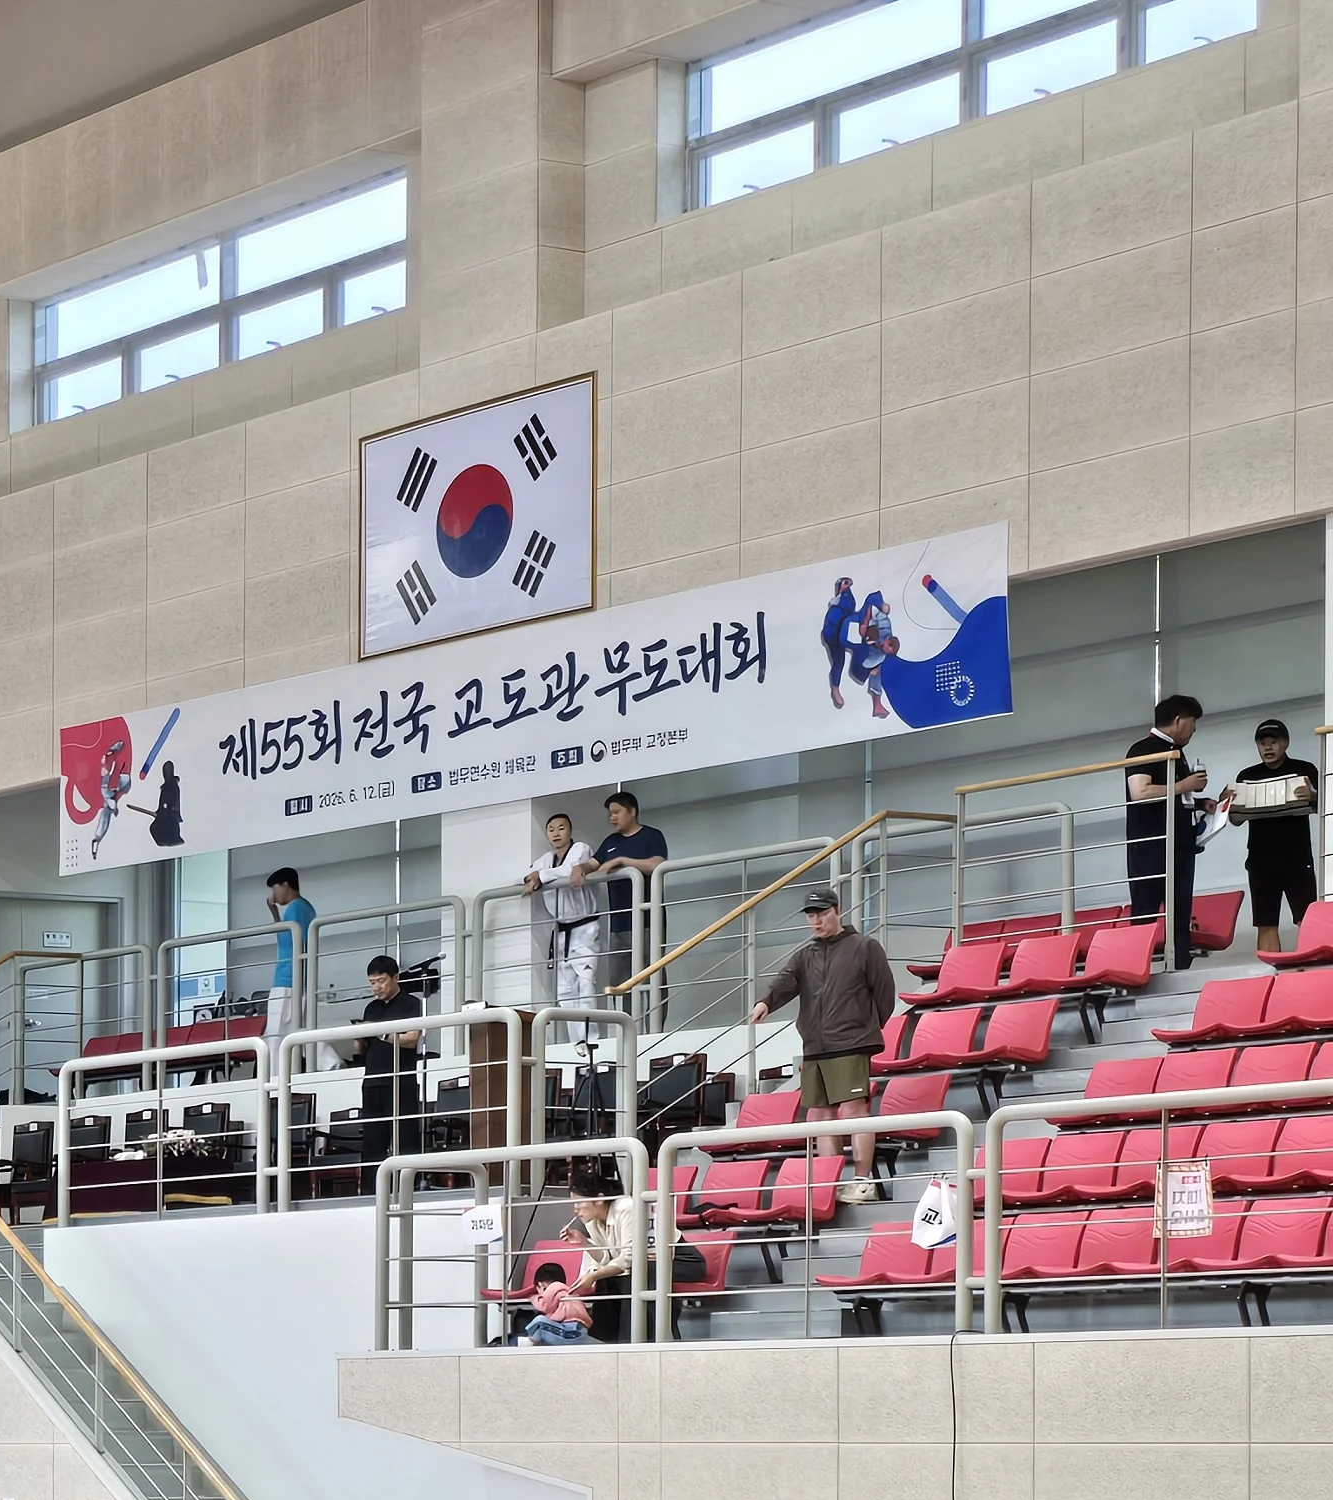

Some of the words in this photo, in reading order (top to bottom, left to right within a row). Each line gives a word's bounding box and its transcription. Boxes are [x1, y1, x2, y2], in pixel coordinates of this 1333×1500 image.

[218, 699, 342, 781] 제55회
[353, 681, 437, 759] 전국
[448, 650, 591, 740] 교도관
[594, 610, 768, 717] 무도대회
[611, 737, 642, 756] 법무부
[646, 728, 688, 749] 교정본부
[448, 761, 501, 786] 법무연수원
